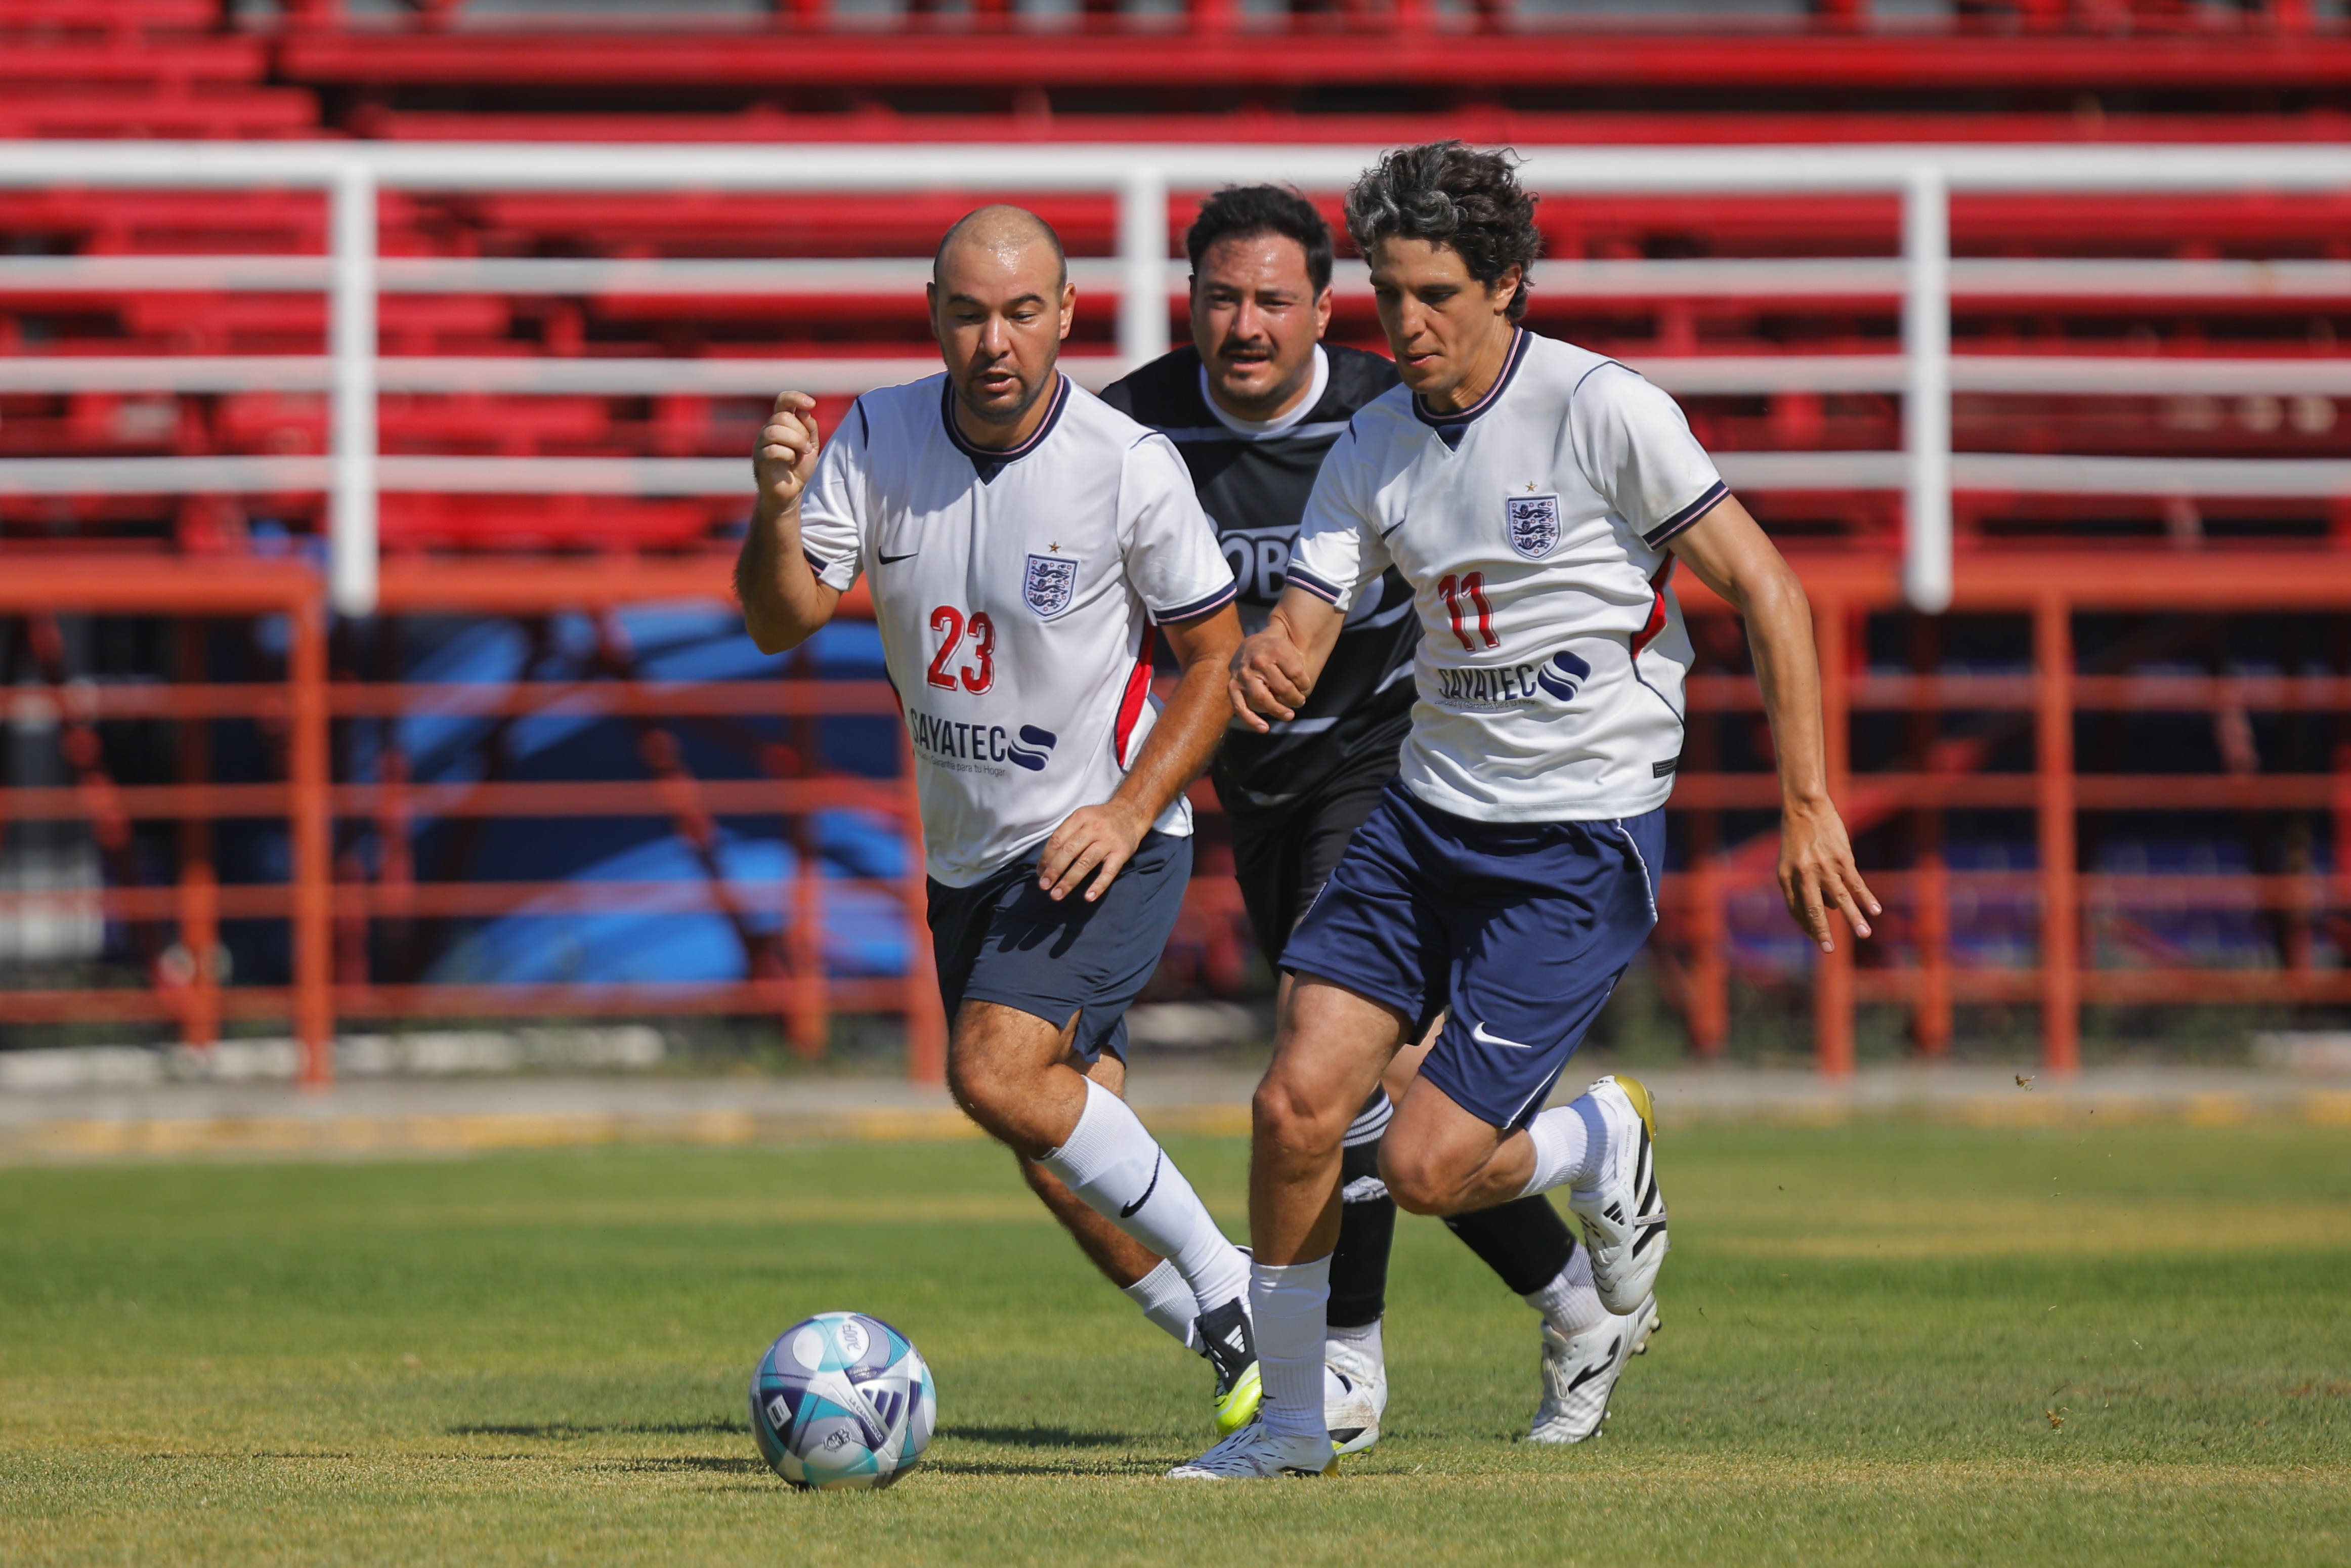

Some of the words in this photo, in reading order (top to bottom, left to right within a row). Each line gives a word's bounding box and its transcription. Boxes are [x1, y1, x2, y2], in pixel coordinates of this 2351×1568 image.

[1437, 571, 1501, 652] 11
[927, 605, 996, 696] 23
[1438, 663, 1537, 702] SAYATEC
[910, 707, 1006, 762] SAYATEC
[957, 764, 972, 773] para
[974, 765, 982, 773] tu
[984, 765, 1005, 777] Hogar
